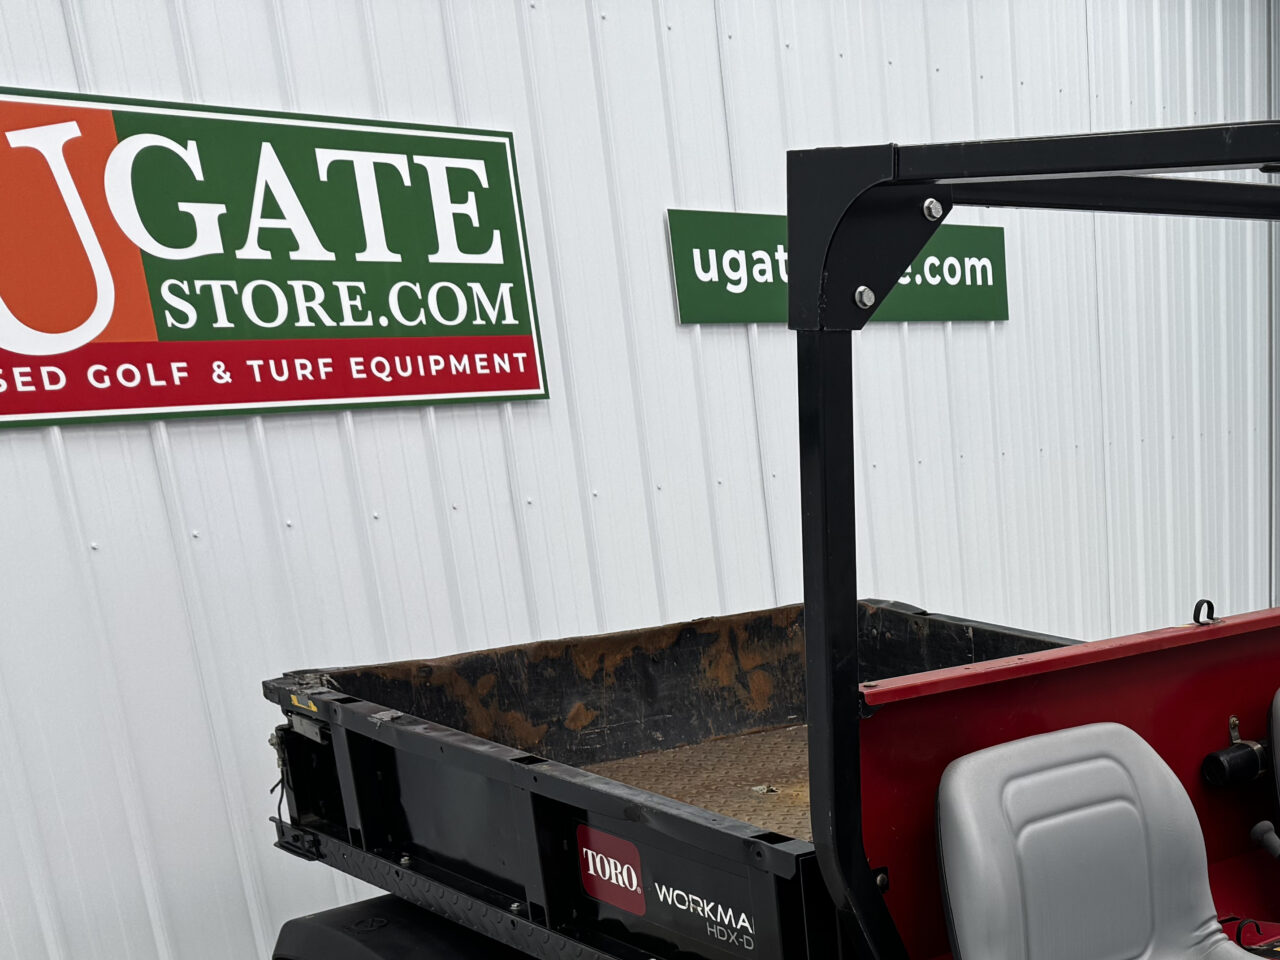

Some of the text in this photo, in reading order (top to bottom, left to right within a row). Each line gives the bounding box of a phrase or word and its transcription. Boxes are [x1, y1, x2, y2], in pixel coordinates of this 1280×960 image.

[160, 277, 519, 329] STORE.COM
[86, 361, 190, 390] GOLF
[212, 361, 233, 384] &
[246, 359, 334, 382] TURF
[350, 352, 528, 381] EQUIPMENT
[583, 847, 638, 891] TORO
[706, 921, 754, 950] HDX-D
